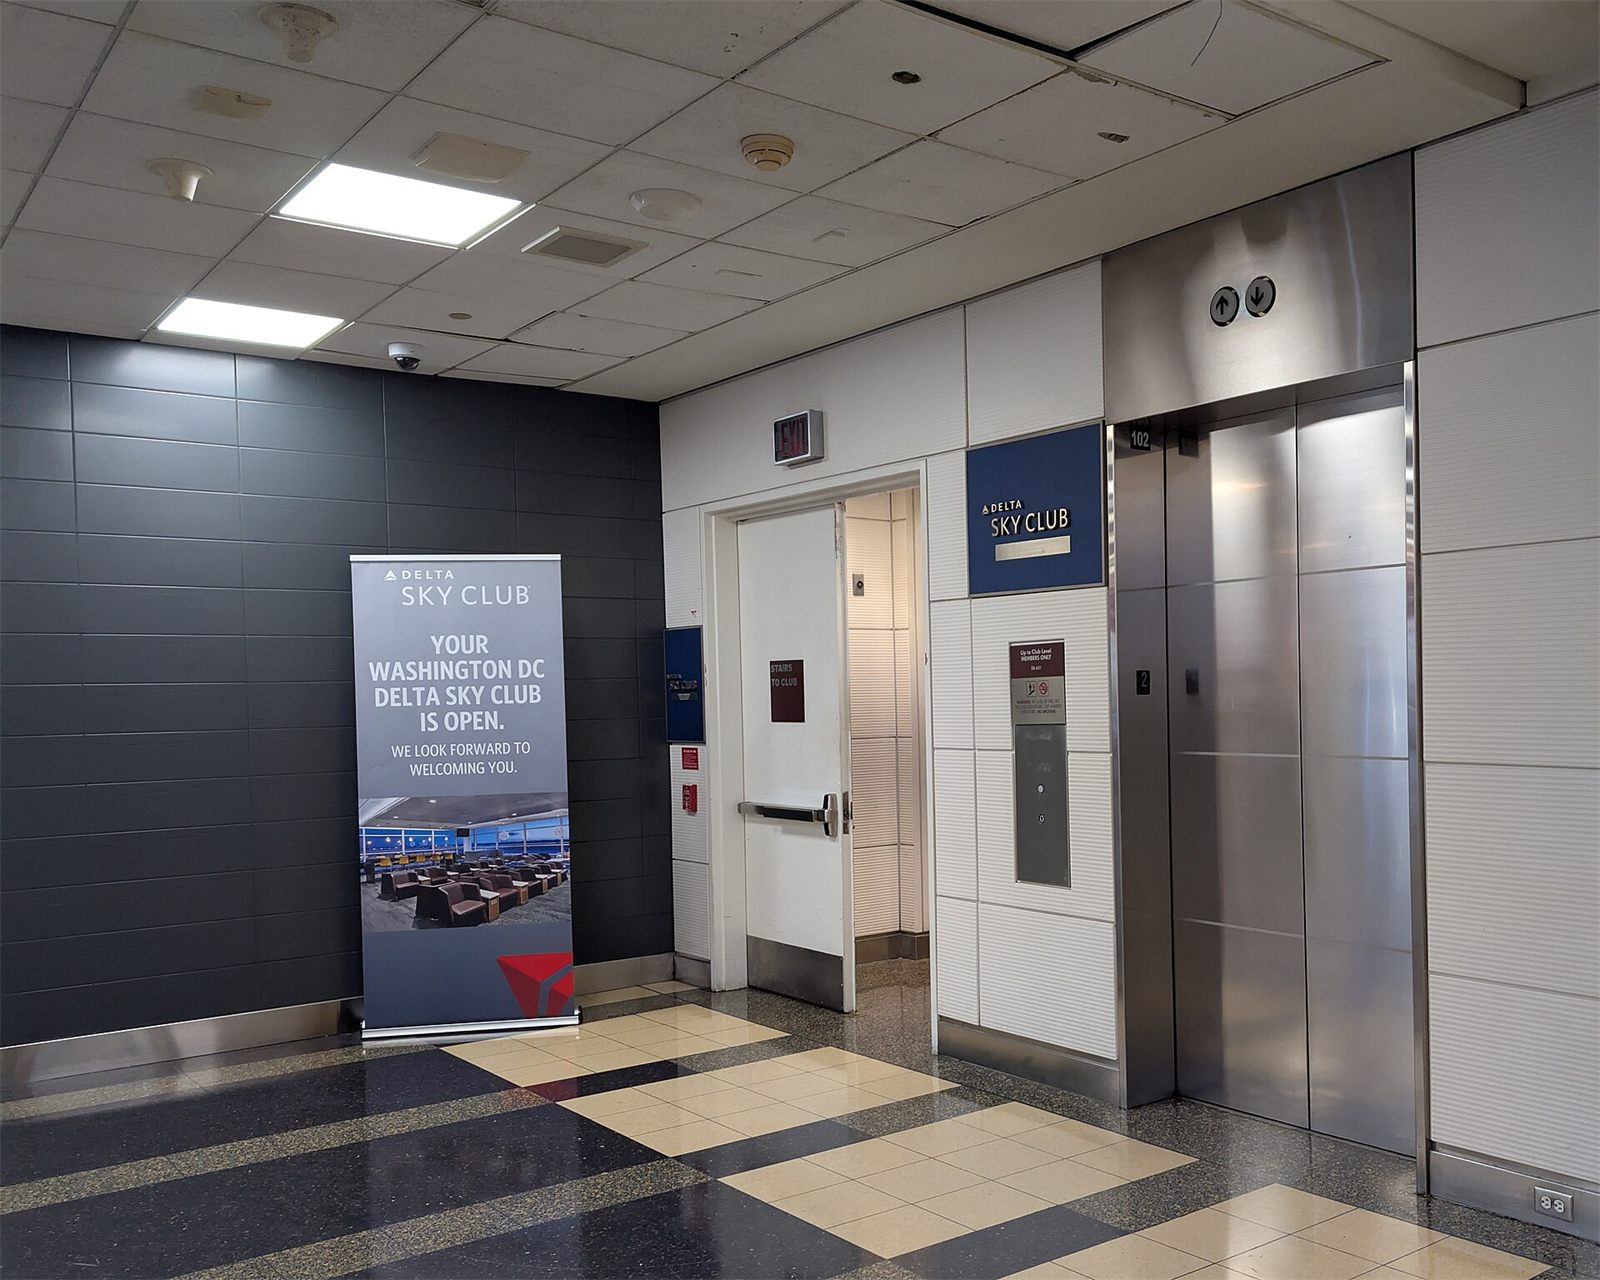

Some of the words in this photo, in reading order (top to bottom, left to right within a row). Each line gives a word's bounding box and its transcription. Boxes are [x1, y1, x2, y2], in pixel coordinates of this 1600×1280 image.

[1131, 430, 1149, 447] 102
[991, 499, 1022, 514] DELTA
[991, 514, 1021, 537] SKY
[1025, 508, 1069, 533] CLUB
[401, 570, 454, 580] DELTA
[401, 585, 453, 606] SKY
[461, 585, 530, 605] CLUB
[430, 634, 489, 655] YOUR
[368, 659, 513, 682] WASHINGTON
[518, 659, 545, 679] DC
[770, 663, 793, 673] STAIRS
[771, 678, 780, 687] TO
[780, 677, 798, 687] CLUB
[1141, 671, 1148, 688] 2
[374, 687, 441, 708] DELTA
[445, 685, 485, 706] SKY
[491, 684, 542, 705] CLUB
[420, 712, 439, 732] IS
[444, 711, 504, 731] OPEN.
[391, 745, 411, 758] WE
[414, 744, 447, 757] LOOK
[450, 742, 511, 757] FORWARD
[514, 741, 531, 754] TO
[410, 762, 485, 776] WELCOMING
[488, 761, 518, 775] YOU.
